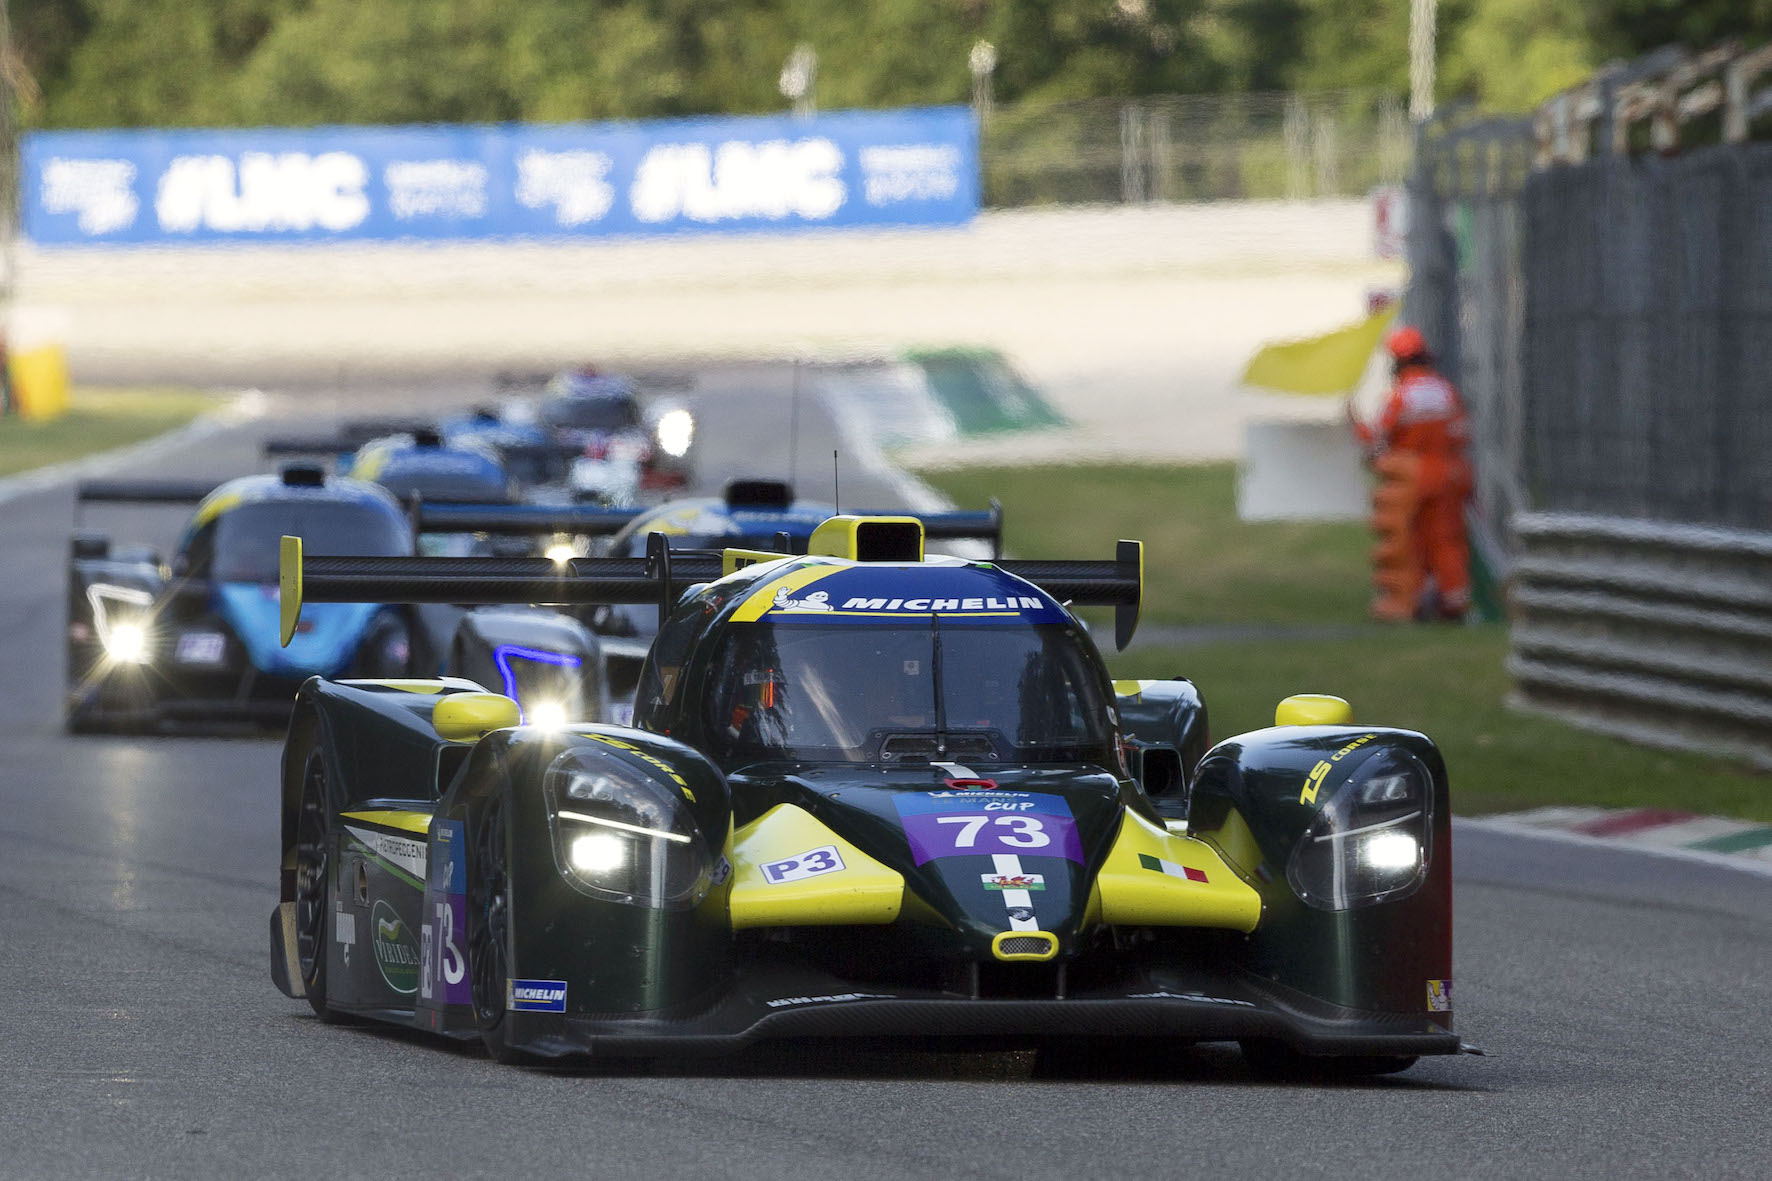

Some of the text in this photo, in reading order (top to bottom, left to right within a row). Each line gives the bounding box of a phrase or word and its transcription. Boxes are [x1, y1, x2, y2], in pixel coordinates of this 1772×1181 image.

[841, 597, 1044, 610] MICHELIN
[1300, 733, 1377, 805] TS CORSE
[984, 802, 1035, 811] CUP
[937, 816, 1051, 848] 73
[767, 850, 837, 881] P3
[436, 903, 466, 985] 73
[514, 988, 565, 1000] MICHELIN
